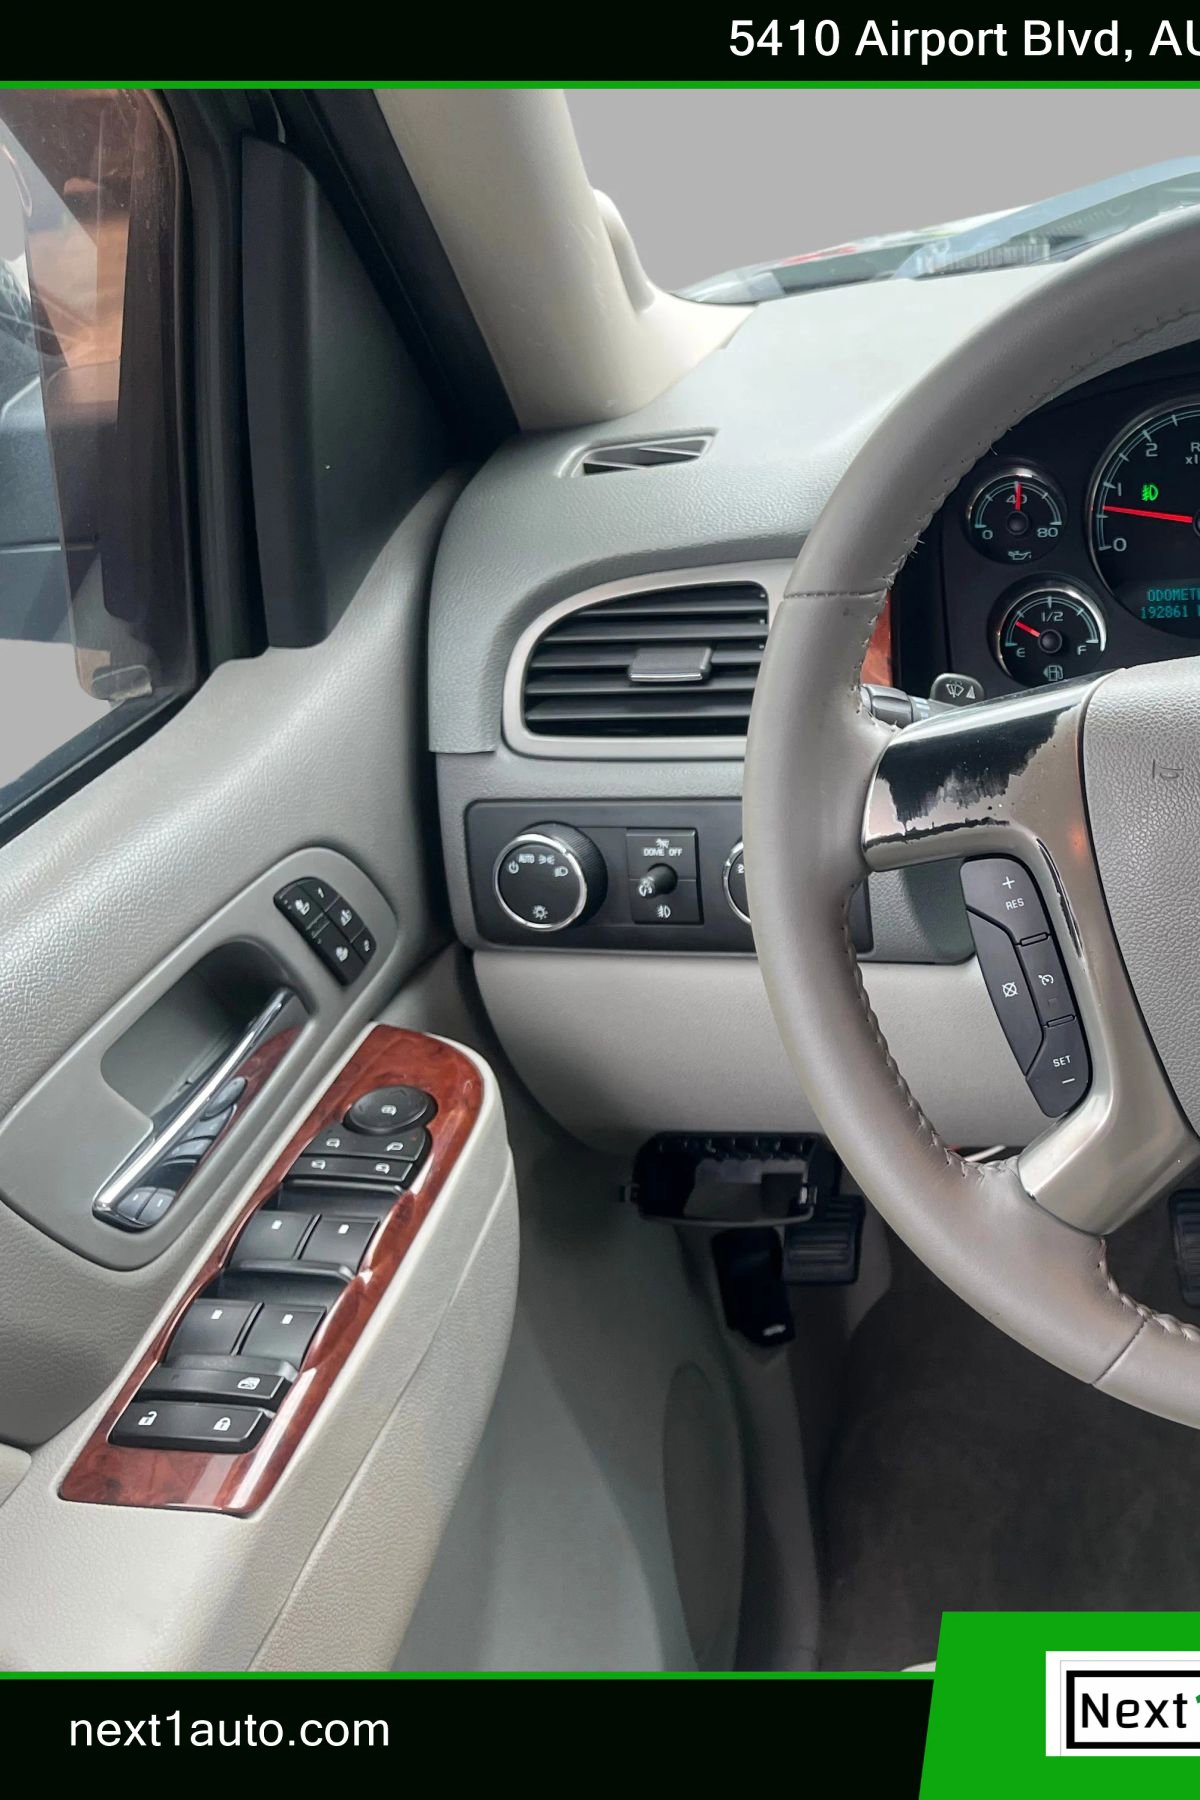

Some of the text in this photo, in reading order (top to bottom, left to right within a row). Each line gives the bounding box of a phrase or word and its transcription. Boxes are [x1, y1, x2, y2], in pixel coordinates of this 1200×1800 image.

[1144, 443, 1159, 458] 2
[1116, 482, 1123, 498] 1
[982, 527, 994, 541] 0
[1036, 526, 1059, 539] 80
[1112, 537, 1128, 553] 0
[1040, 611, 1064, 623] 1/2
[1141, 604, 1188, 619] 192861
[1076, 645, 1088, 658] F
[643, 848, 683, 857] DOME OFF
[1005, 897, 1025, 911] RES
[1052, 1055, 1072, 1068] SET
